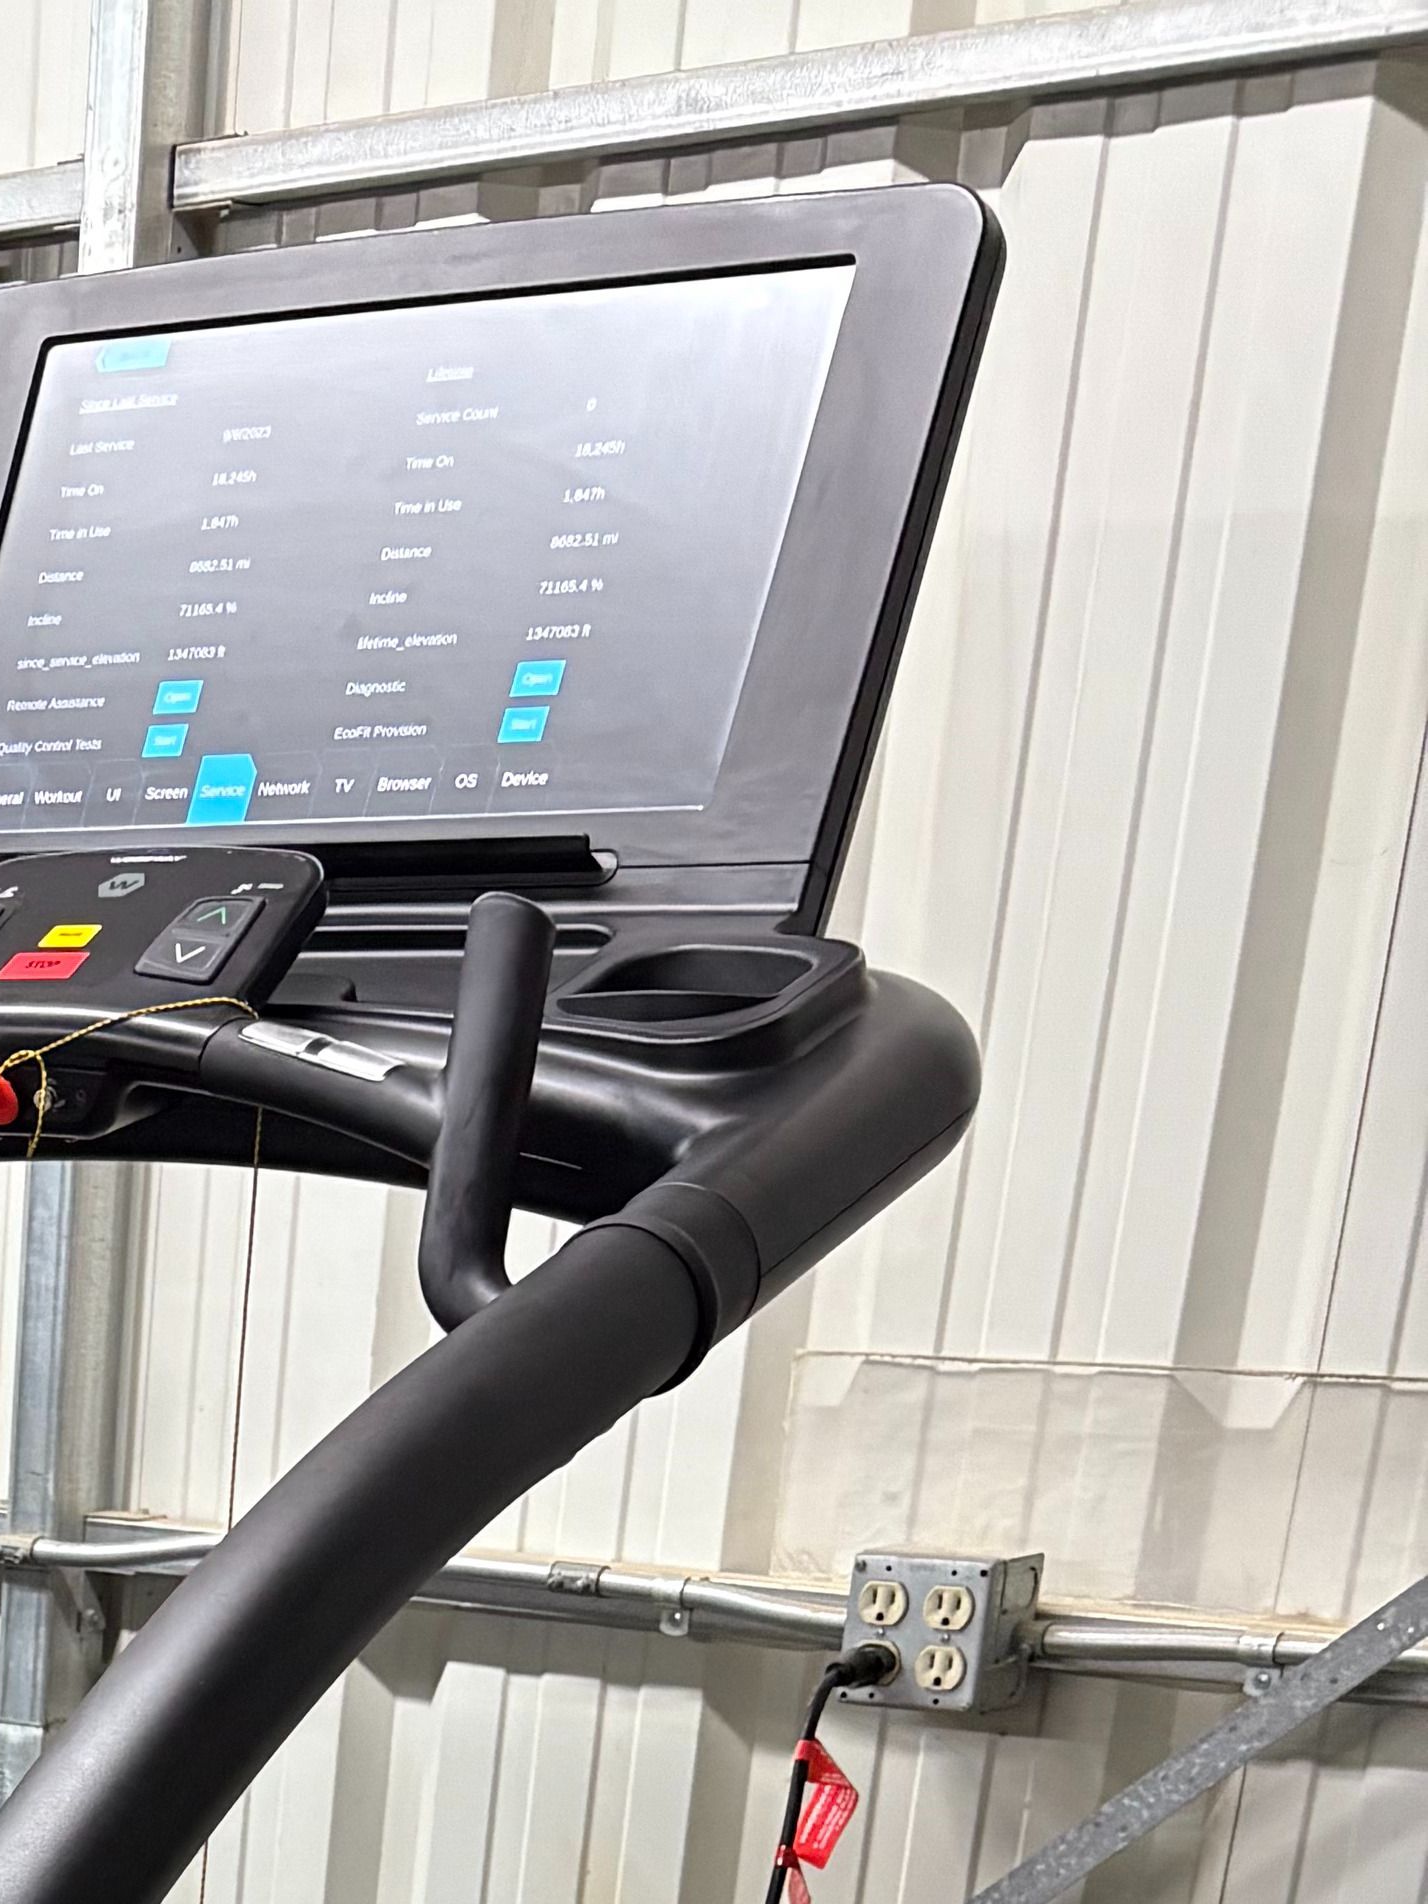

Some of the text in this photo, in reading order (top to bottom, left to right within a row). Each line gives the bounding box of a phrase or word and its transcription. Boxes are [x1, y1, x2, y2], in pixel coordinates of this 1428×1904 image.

[416, 405, 499, 425] Service Count
[69, 440, 135, 456] Last Service
[406, 454, 454, 470] Time On
[60, 483, 105, 498] Time On
[394, 498, 463, 514] Time in Use
[49, 525, 111, 541] Time in Use
[602, 531, 619, 545] mi
[380, 545, 432, 561] Distance
[235, 557, 251, 570] mi
[38, 569, 84, 584] Distance
[369, 590, 408, 605] Incline
[27, 613, 62, 627] Incline
[17, 651, 140, 671] since_service_elevation
[345, 680, 406, 698] Diagnostic
[7, 696, 105, 712] Remote Assistance
[333, 723, 427, 741] EcoFit Provision
[34, 739, 73, 753] Control
[75, 738, 103, 752] Tests
[335, 778, 355, 794] TV
[376, 776, 432, 792] Browser
[454, 773, 479, 789] OS
[501, 771, 549, 788] Device
[106, 788, 123, 802] UI
[145, 786, 188, 801] Screen
[200, 784, 247, 798] Service
[258, 780, 311, 797] Network
[34, 789, 83, 805] Workout
